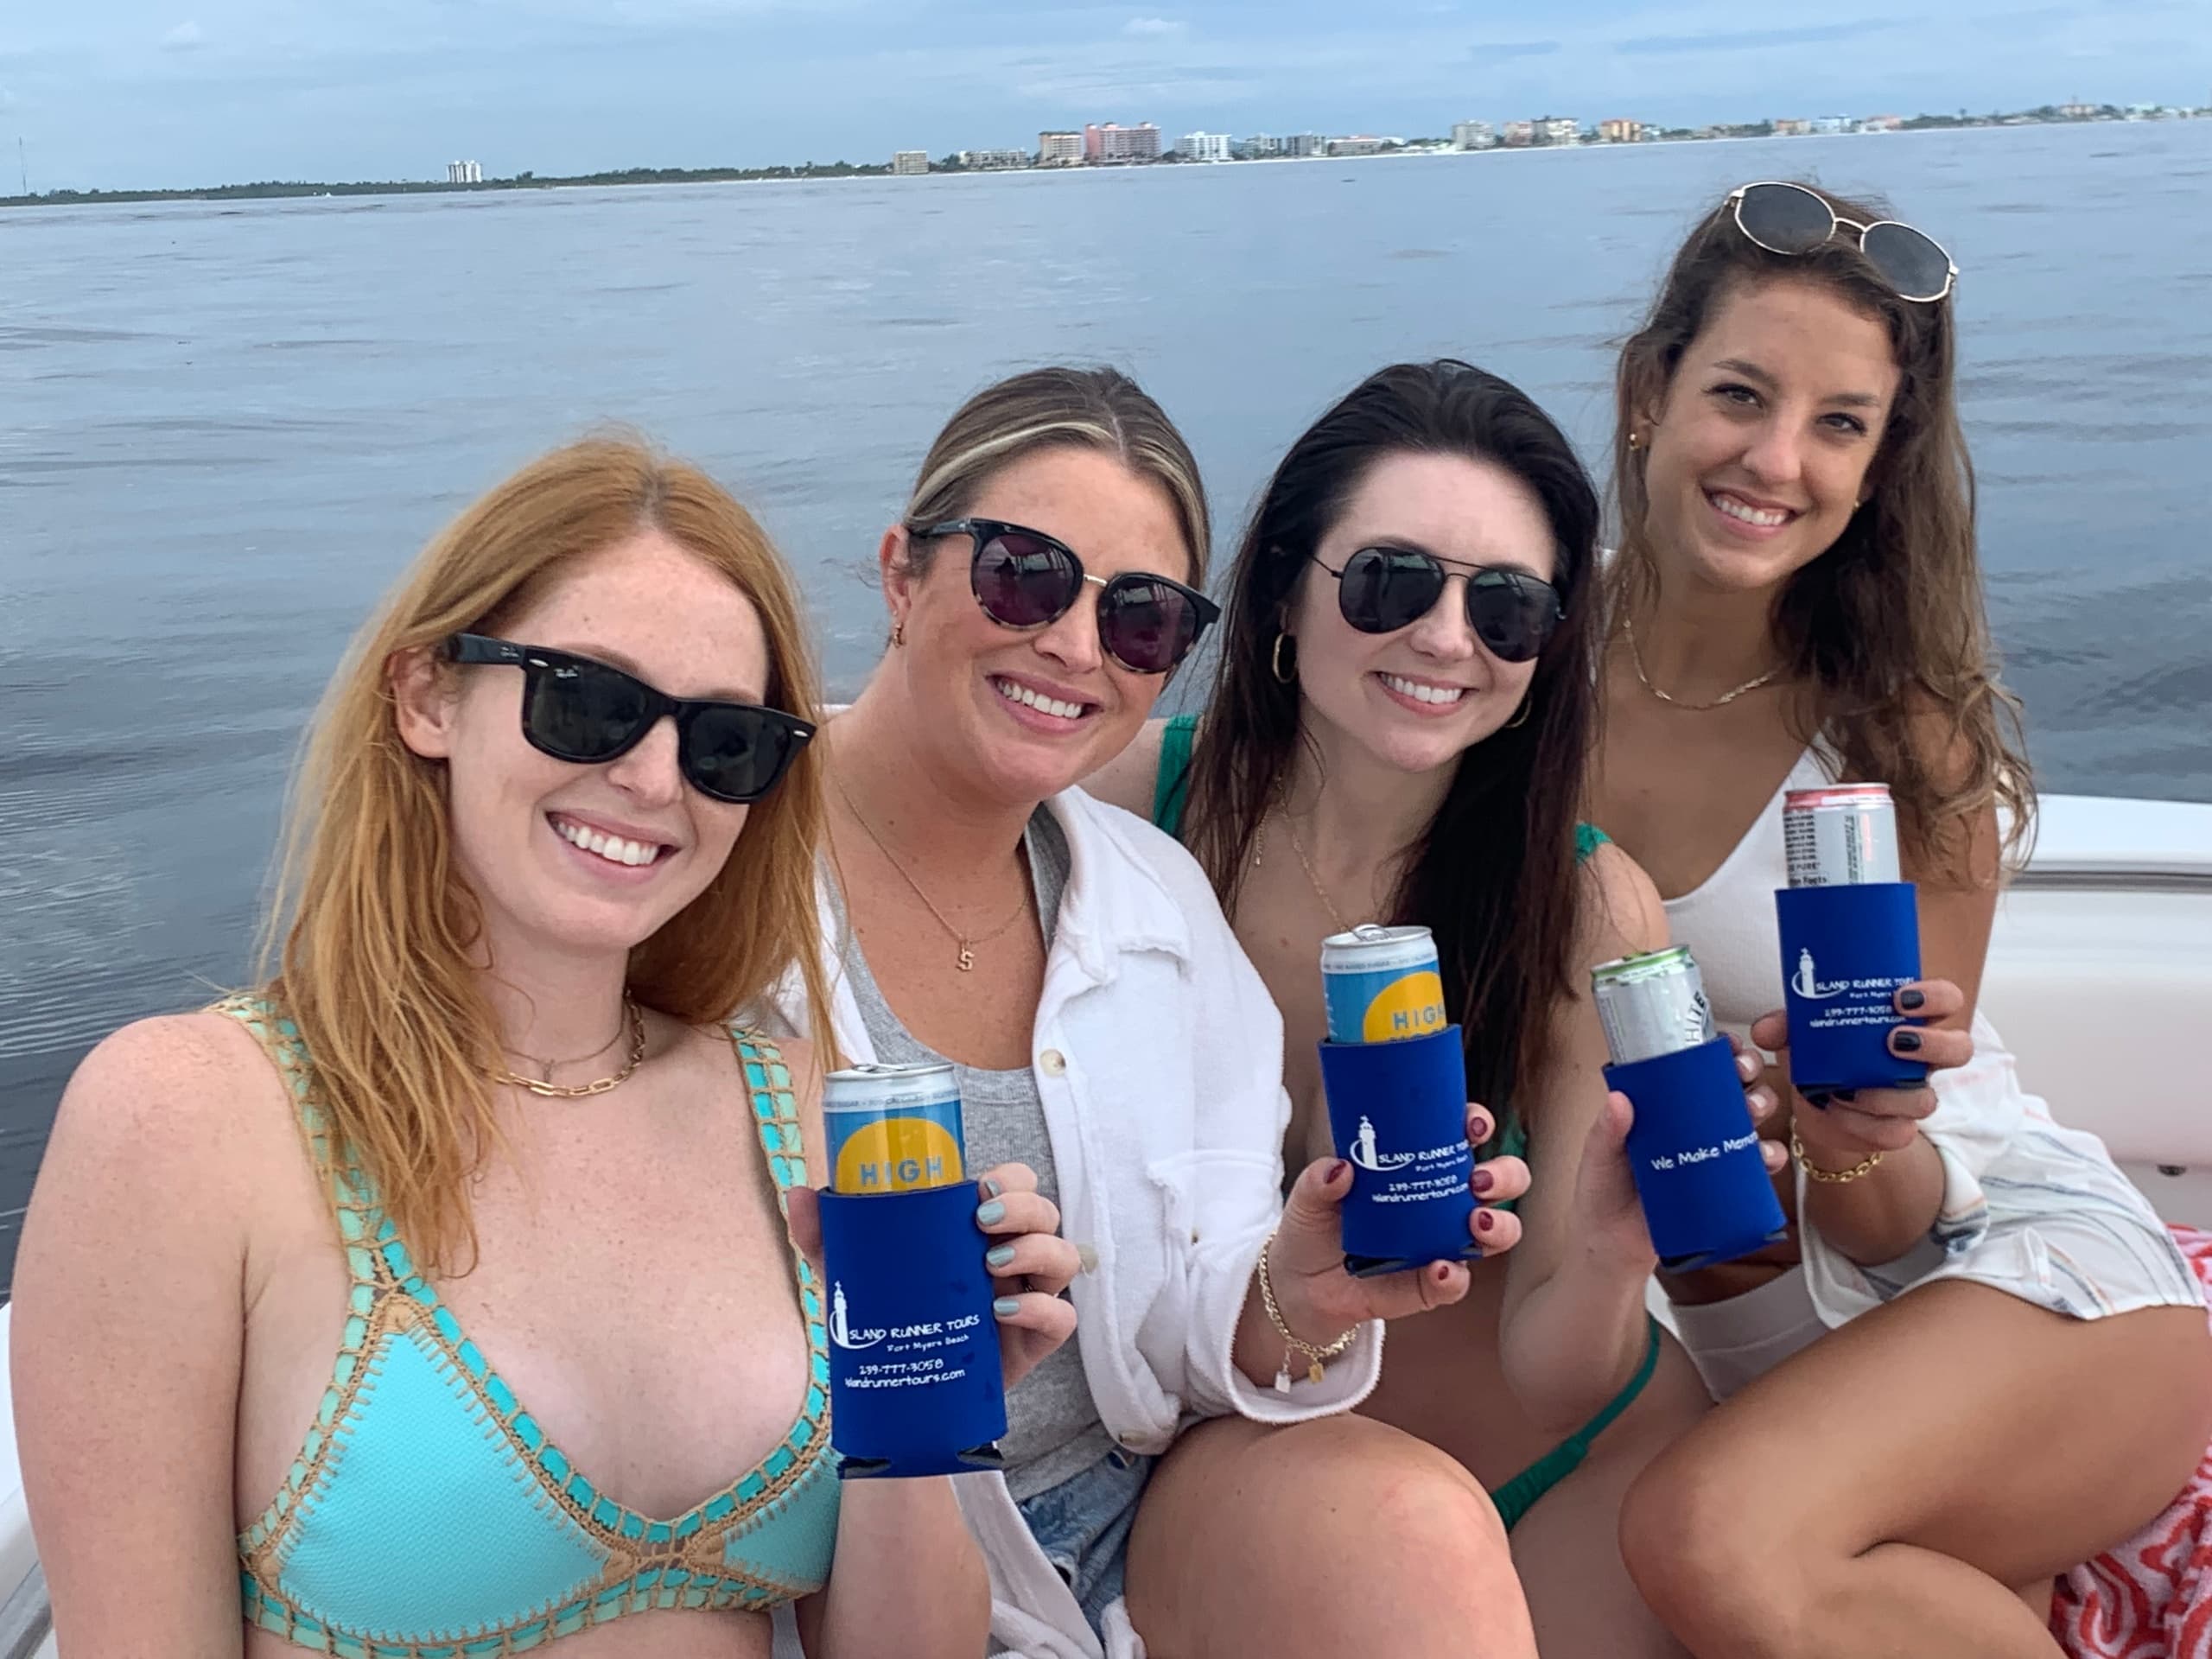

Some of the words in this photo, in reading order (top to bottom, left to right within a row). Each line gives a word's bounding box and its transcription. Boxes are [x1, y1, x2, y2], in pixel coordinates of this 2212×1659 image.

[1852, 977, 1892, 989] RUNNER
[1417, 1145, 1456, 1161] RUNNER
[1650, 1155, 1675, 1170] We
[1677, 1147, 1719, 1166] Make
[859, 1155, 944, 1186] HIGH
[890, 1322, 944, 1339] RUNNER
[946, 1313, 981, 1331] TOURS
[887, 1343, 911, 1353] Fort
[912, 1339, 943, 1352] Myers
[944, 1333, 969, 1346] Beach
[858, 1357, 944, 1376] 239-777-3058
